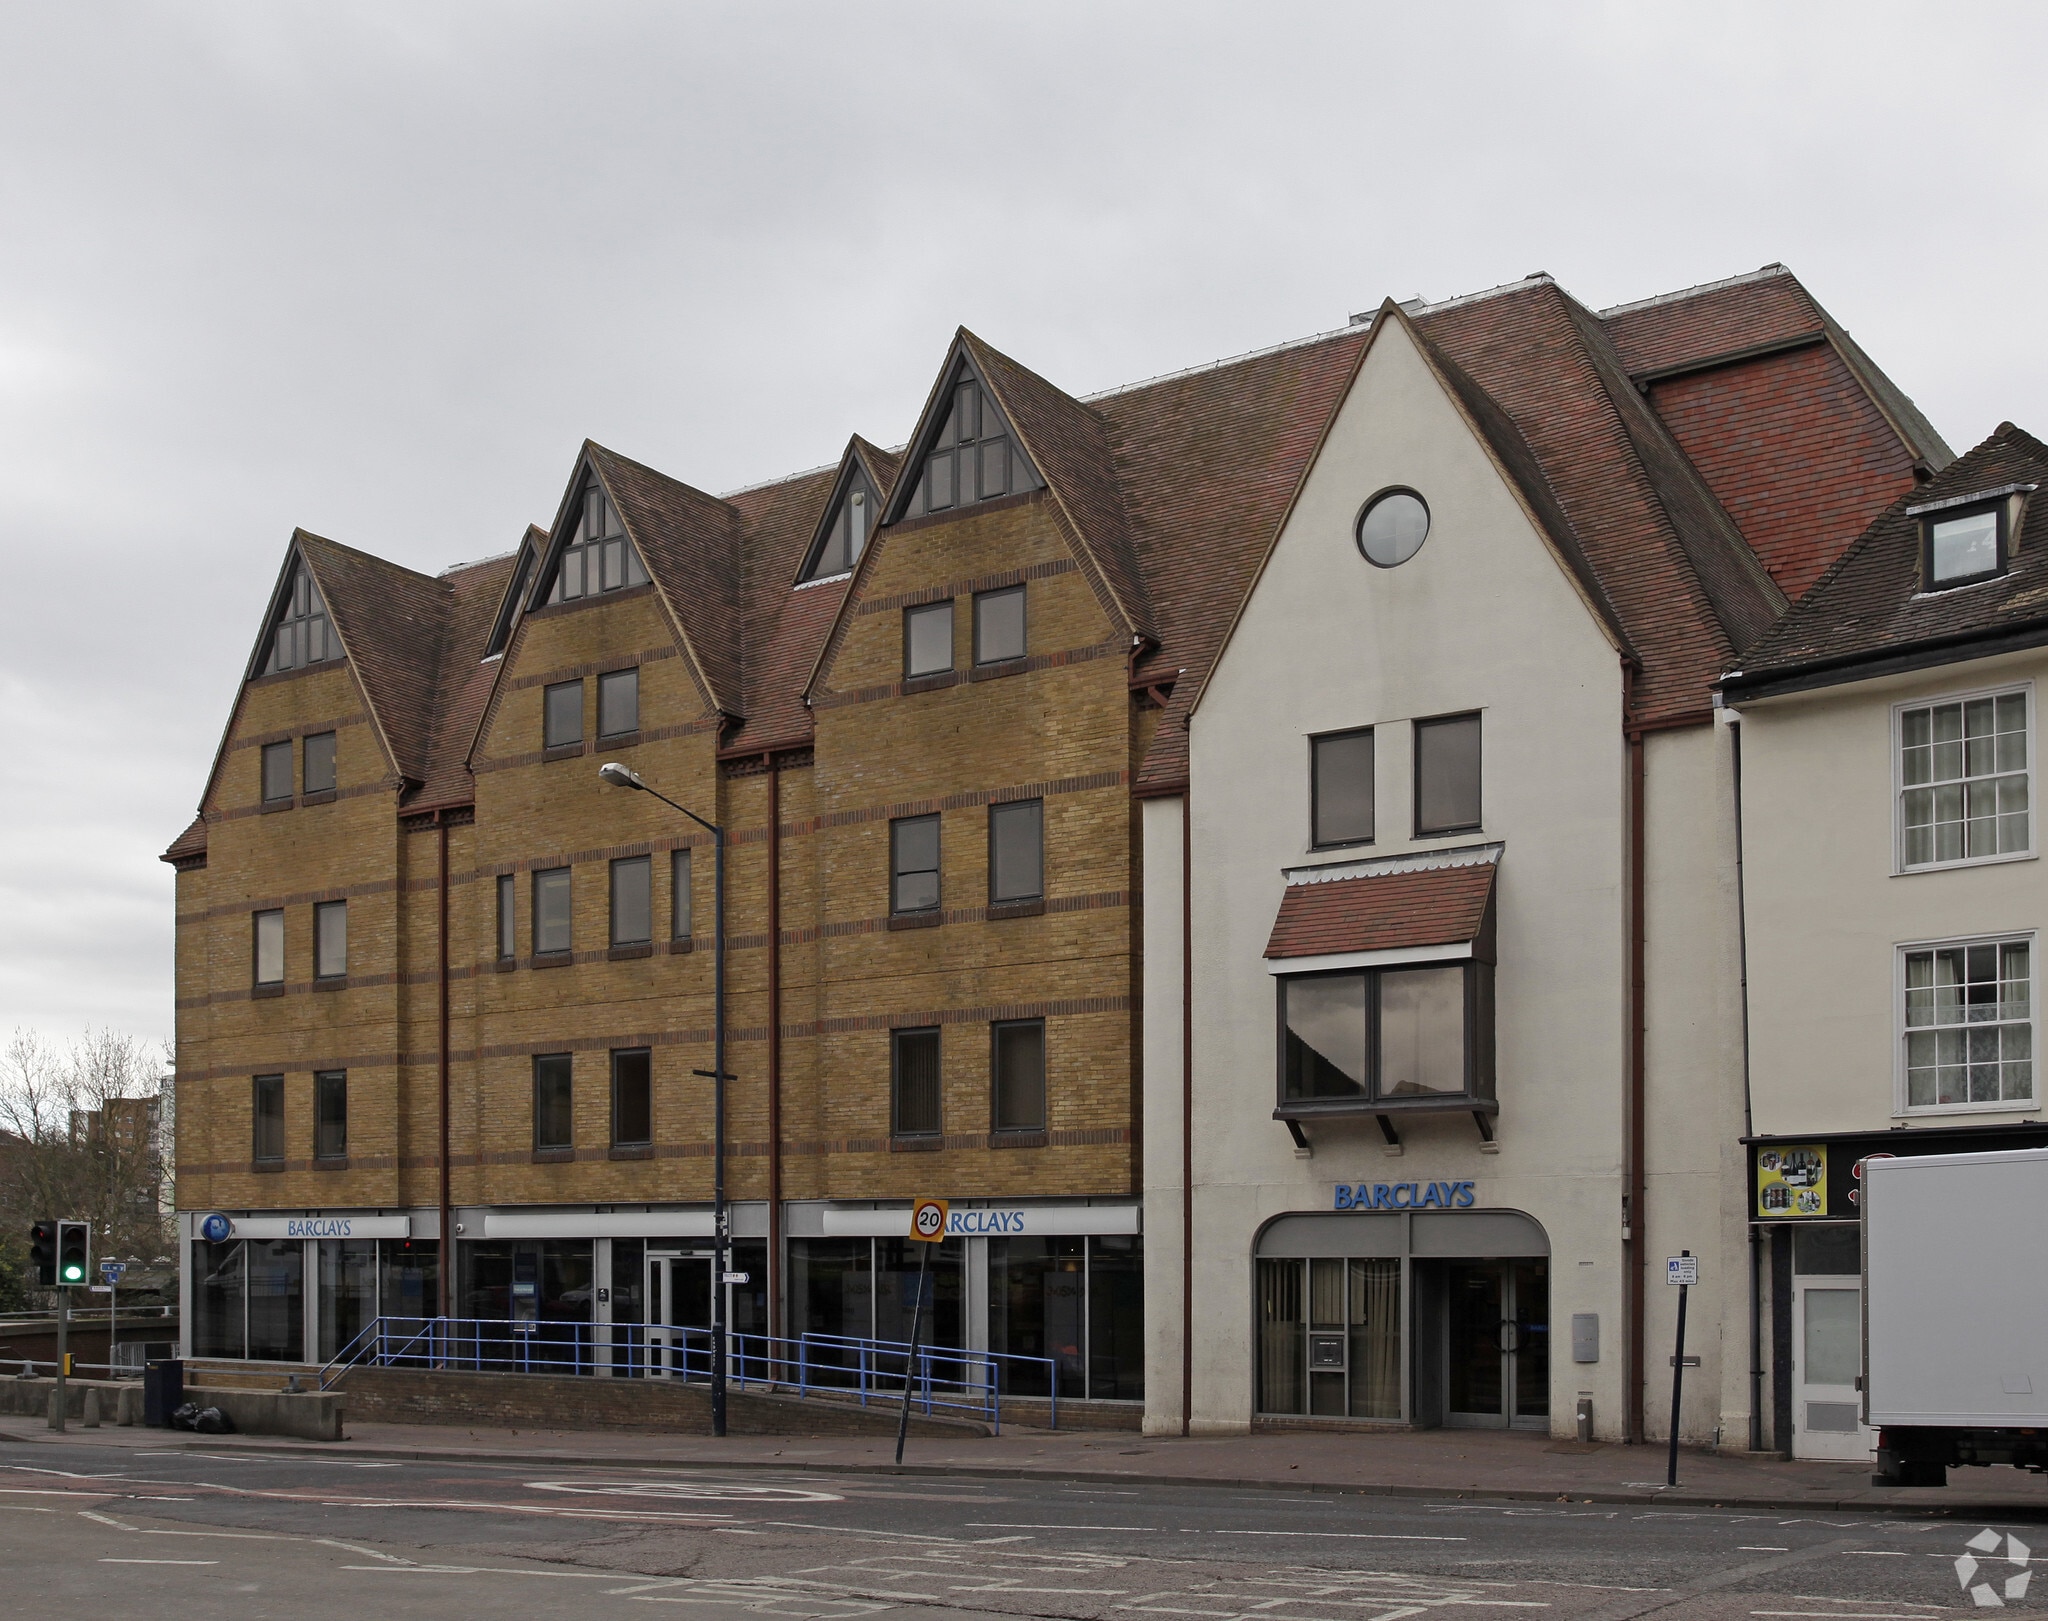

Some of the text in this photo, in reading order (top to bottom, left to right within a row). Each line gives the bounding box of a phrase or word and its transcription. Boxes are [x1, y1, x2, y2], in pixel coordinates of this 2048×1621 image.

[1334, 1181, 1475, 1209] BARCLAYS
[288, 1219, 351, 1236] BARCLAYS
[919, 1211, 940, 1227] 20
[944, 1212, 1025, 1233] RCLAYS
